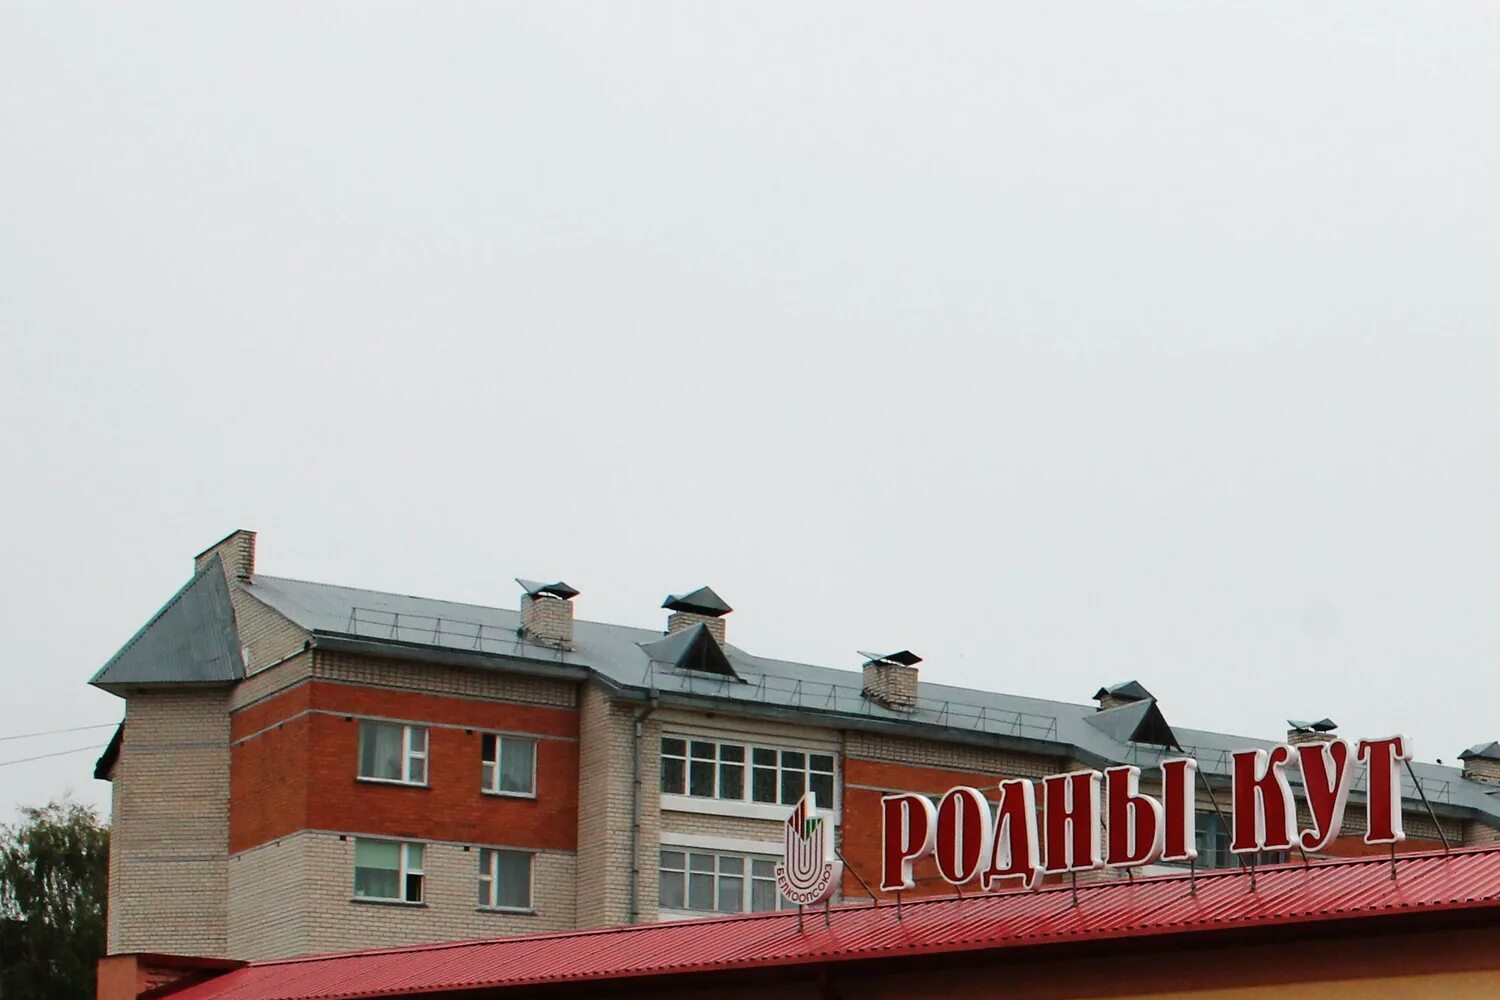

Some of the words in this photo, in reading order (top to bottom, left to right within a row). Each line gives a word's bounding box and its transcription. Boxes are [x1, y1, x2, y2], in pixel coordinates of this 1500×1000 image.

[880, 757, 1198, 891] РОДНЫ
[1230, 734, 1413, 852] КУТ
[776, 863, 833, 903] БЕЛКООПСОЮЗ
